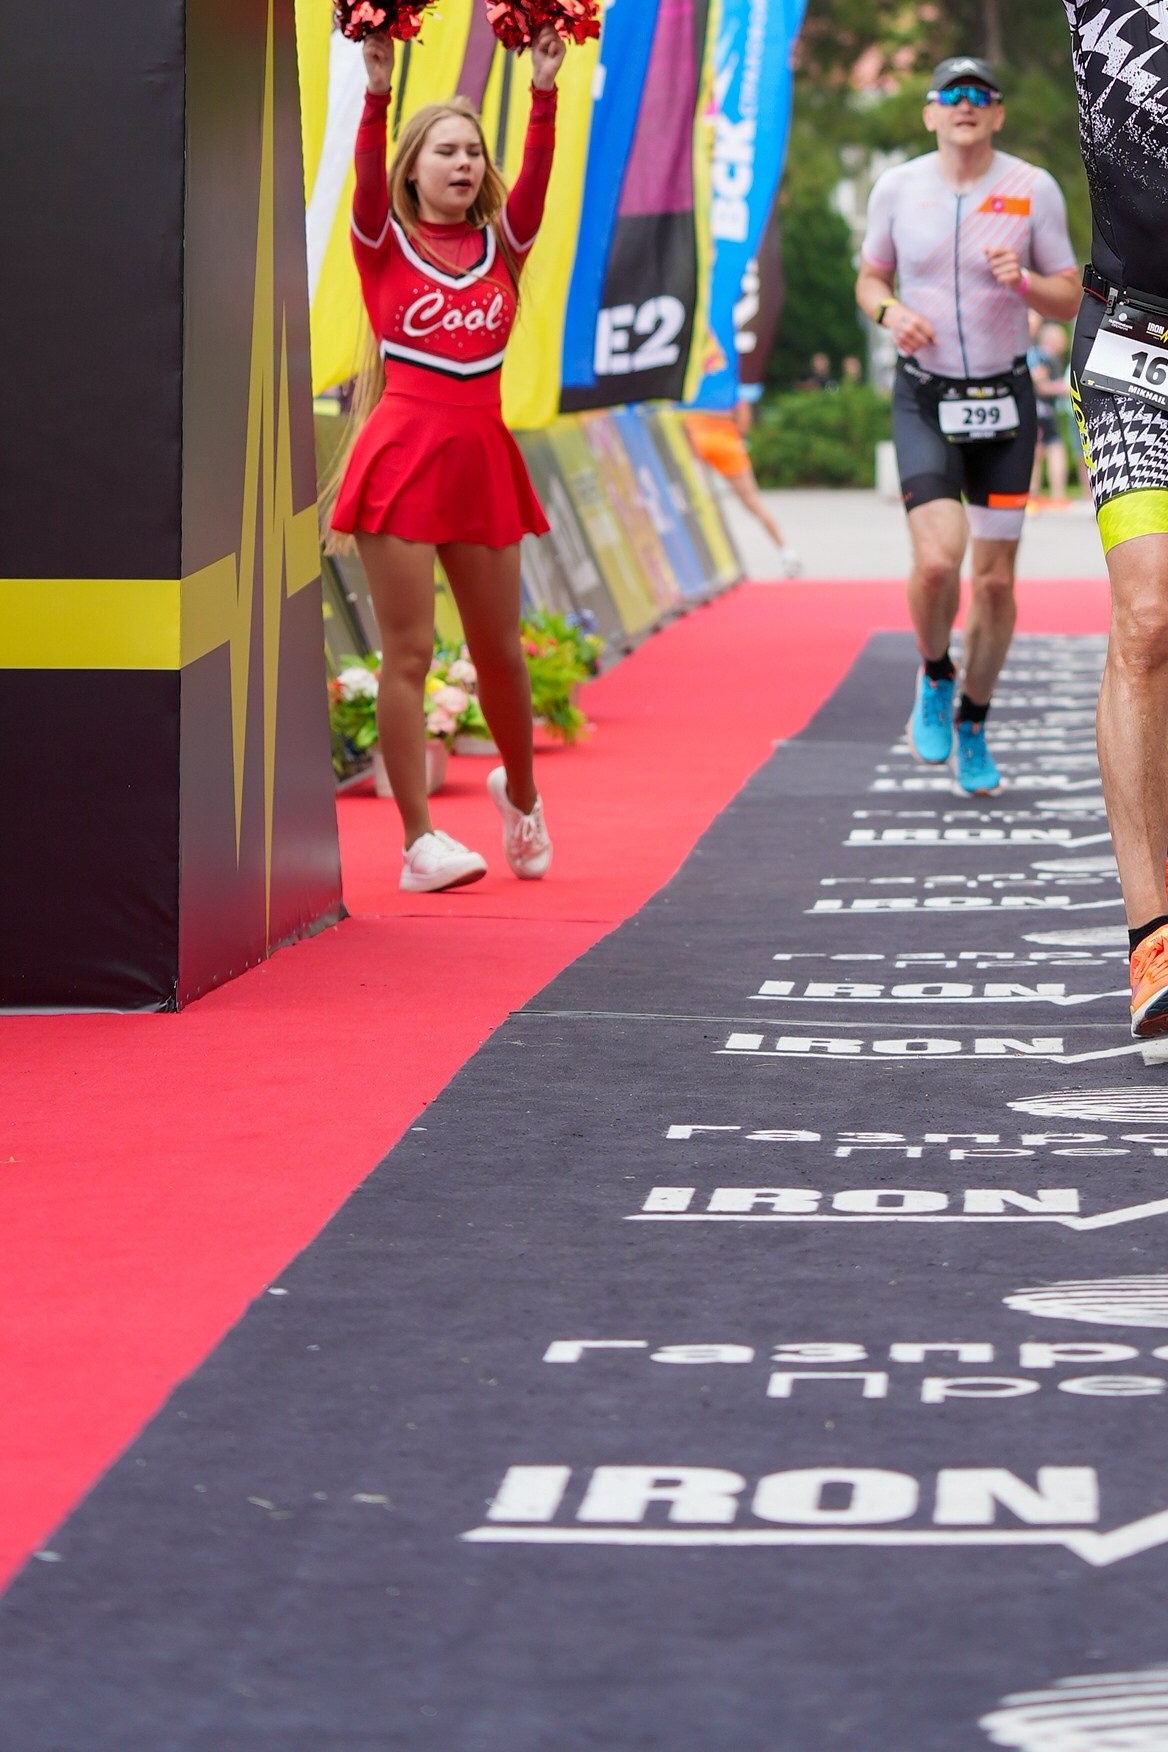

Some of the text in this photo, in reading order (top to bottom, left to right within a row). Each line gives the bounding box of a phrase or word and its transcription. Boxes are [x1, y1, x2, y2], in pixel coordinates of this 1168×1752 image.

[711, 112, 757, 243] ВСК
[402, 292, 504, 337] Cool
[593, 294, 686, 377] E2
[1147, 322, 1165, 334] IRON
[1127, 384, 1167, 406] MIKHAIL
[961, 406, 1001, 425] 299
[757, 980, 1065, 999] IRON
[724, 1031, 1065, 1055] IRON
[641, 1186, 1081, 1214] IRON
[486, 1465, 1099, 1525] IRON
